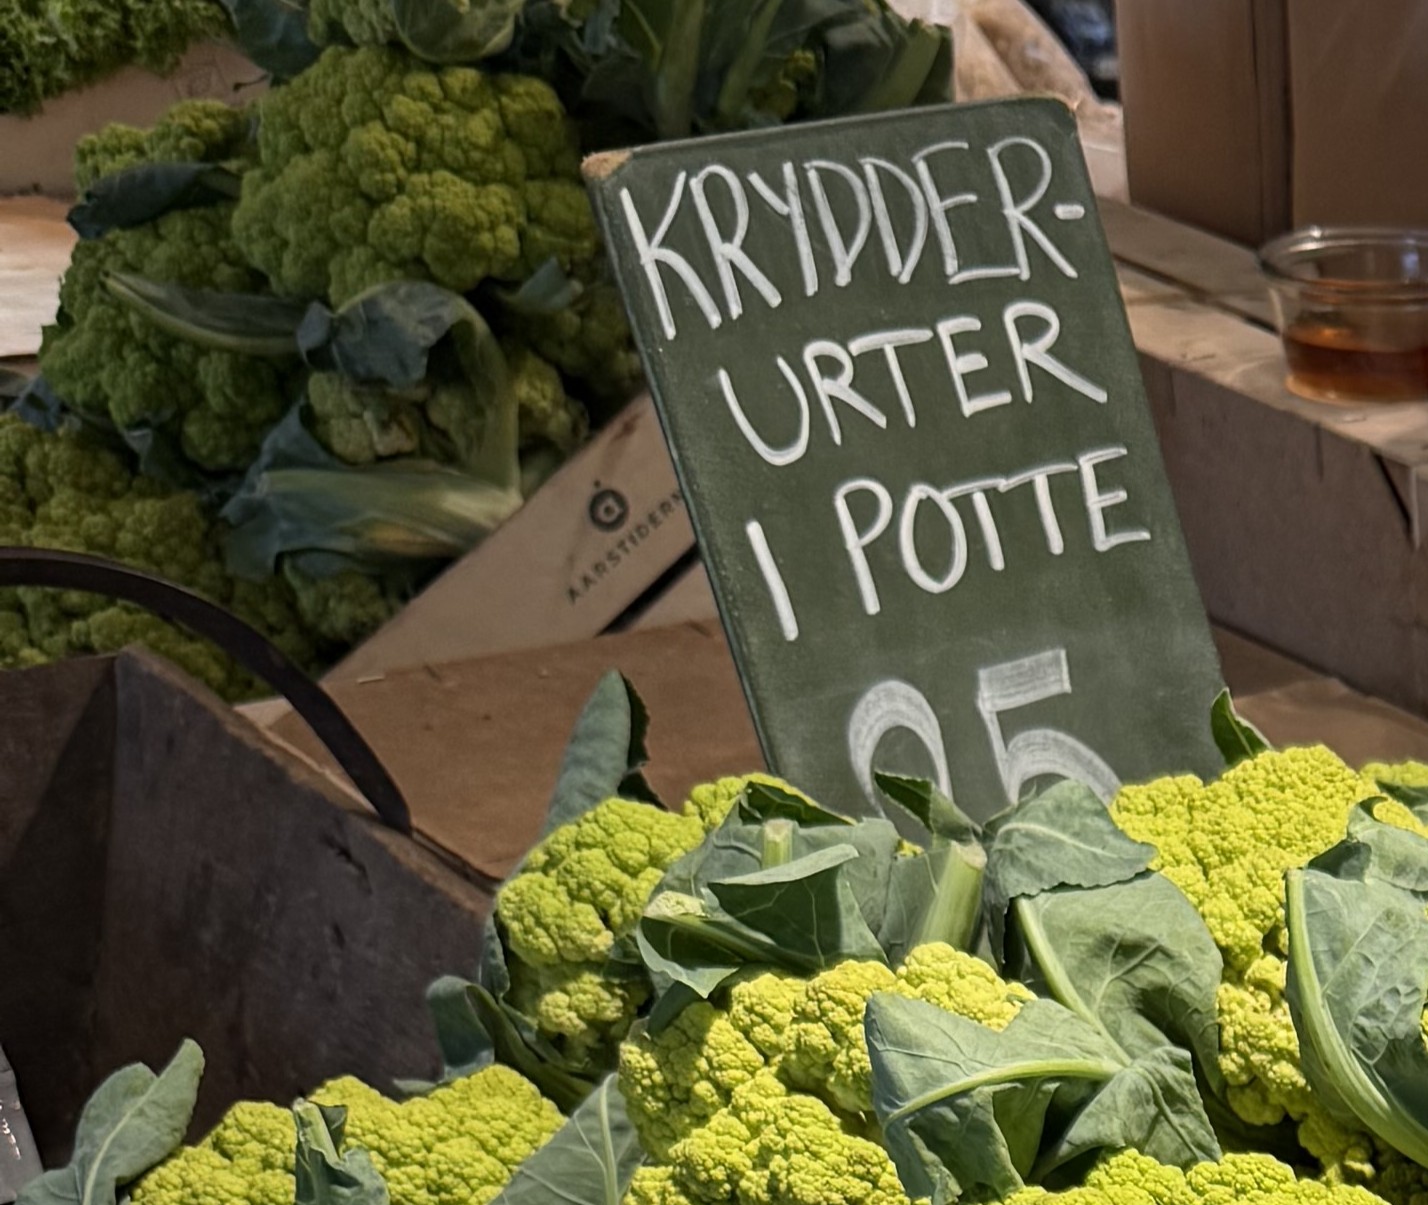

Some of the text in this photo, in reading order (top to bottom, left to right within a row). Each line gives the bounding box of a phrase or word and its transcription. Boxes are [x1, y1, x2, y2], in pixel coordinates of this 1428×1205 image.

[620, 137, 1086, 341] KRYDDER-
[718, 301, 1108, 467] URTER
[833, 446, 1152, 616] POTTE
